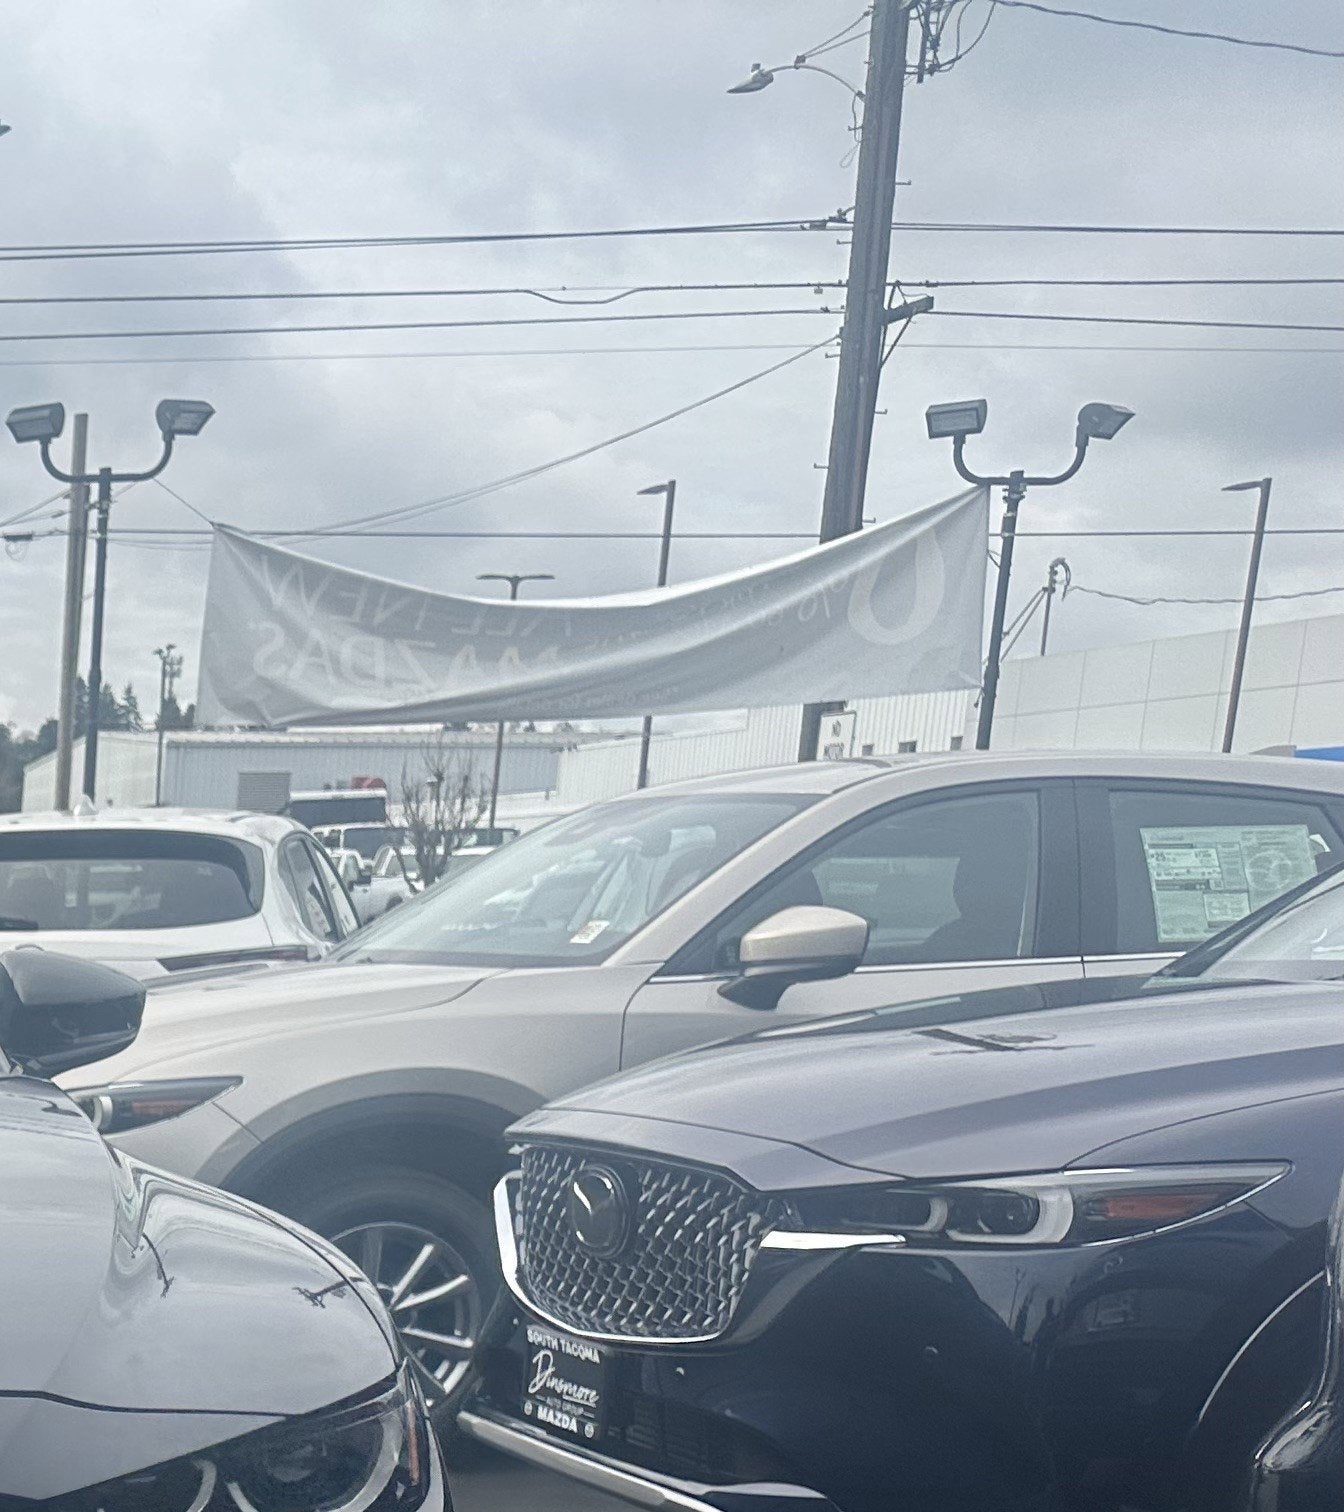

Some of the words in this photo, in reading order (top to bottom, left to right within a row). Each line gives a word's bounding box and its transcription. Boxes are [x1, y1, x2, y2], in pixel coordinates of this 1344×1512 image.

[527, 1328, 559, 1351] SOUTH
[559, 1340, 600, 1364] TACOMA
[528, 1349, 600, 1404] Dinsmore
[537, 1405, 578, 1433] MAZDA
